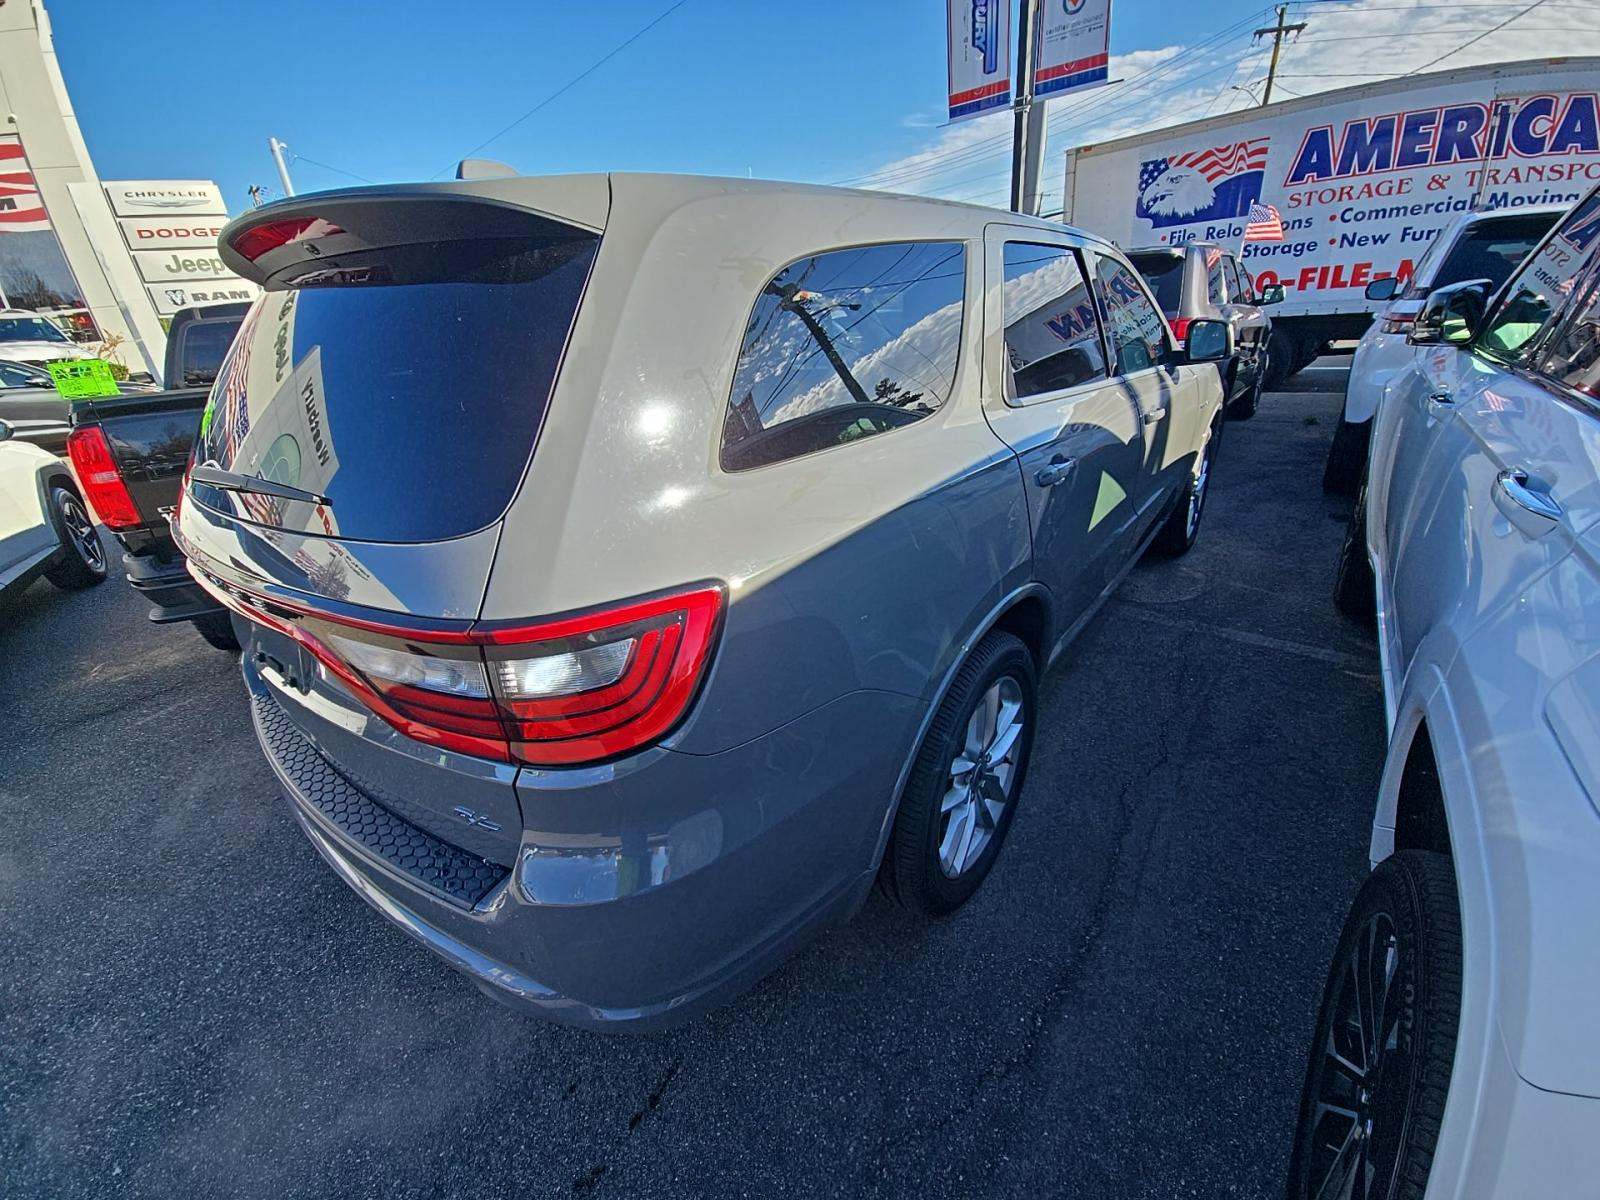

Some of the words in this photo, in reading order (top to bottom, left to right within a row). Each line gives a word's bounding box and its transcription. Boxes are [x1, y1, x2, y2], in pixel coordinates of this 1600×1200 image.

[1283, 91, 1600, 188] AMERICA
[124, 190, 208, 198] CHRYSLER
[1288, 177, 1413, 209] STORAGE
[1426, 173, 1451, 191] &
[1340, 192, 1480, 223] Commercial
[137, 228, 222, 239] DODGE
[1169, 229, 1197, 244] File
[1340, 232, 1390, 248] New
[1243, 240, 1318, 258] Storage
[165, 255, 225, 275] Jeep
[191, 291, 251, 302] RAM
